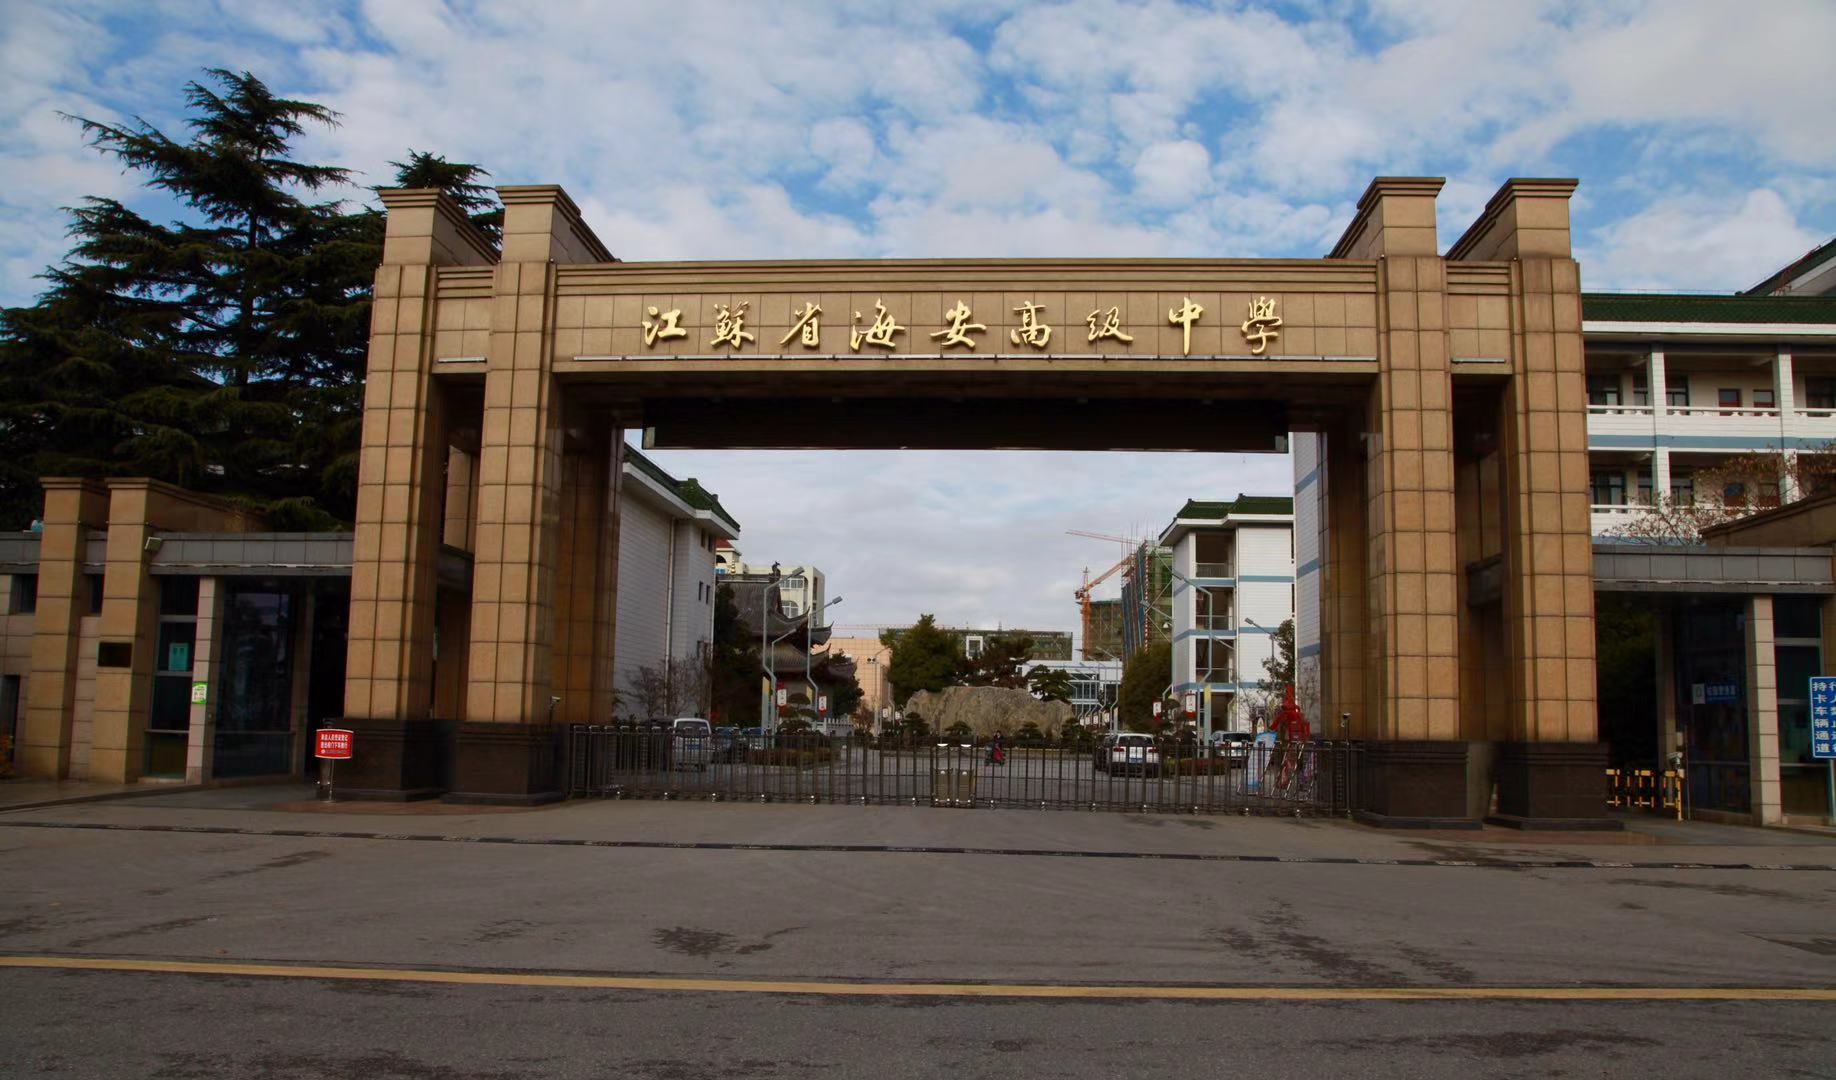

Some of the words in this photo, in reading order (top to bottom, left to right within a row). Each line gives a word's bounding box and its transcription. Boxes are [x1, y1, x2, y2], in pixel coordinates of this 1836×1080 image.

[1813, 681, 1831, 753] 持卡车辆通道
